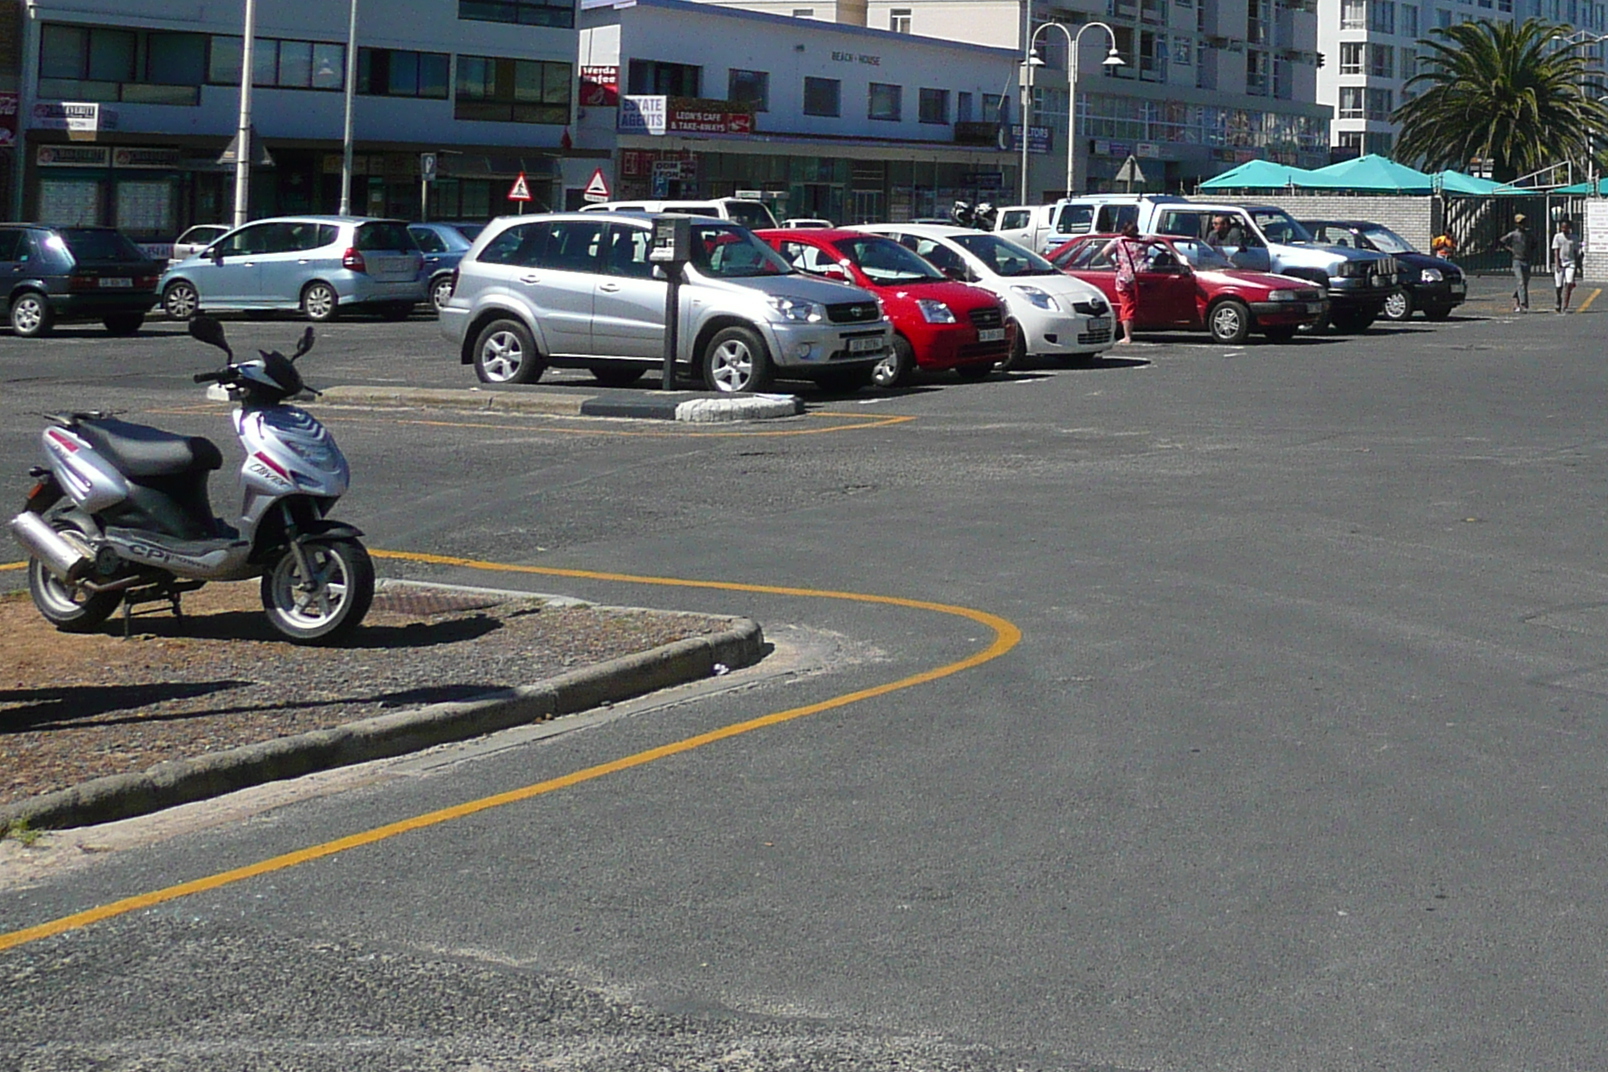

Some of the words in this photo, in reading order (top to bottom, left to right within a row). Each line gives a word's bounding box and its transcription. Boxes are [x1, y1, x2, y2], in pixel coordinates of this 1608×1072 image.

[623, 98, 662, 111] ESTATE
[621, 113, 663, 127] AGENTS
[1012, 125, 1048, 138] RELTORS
